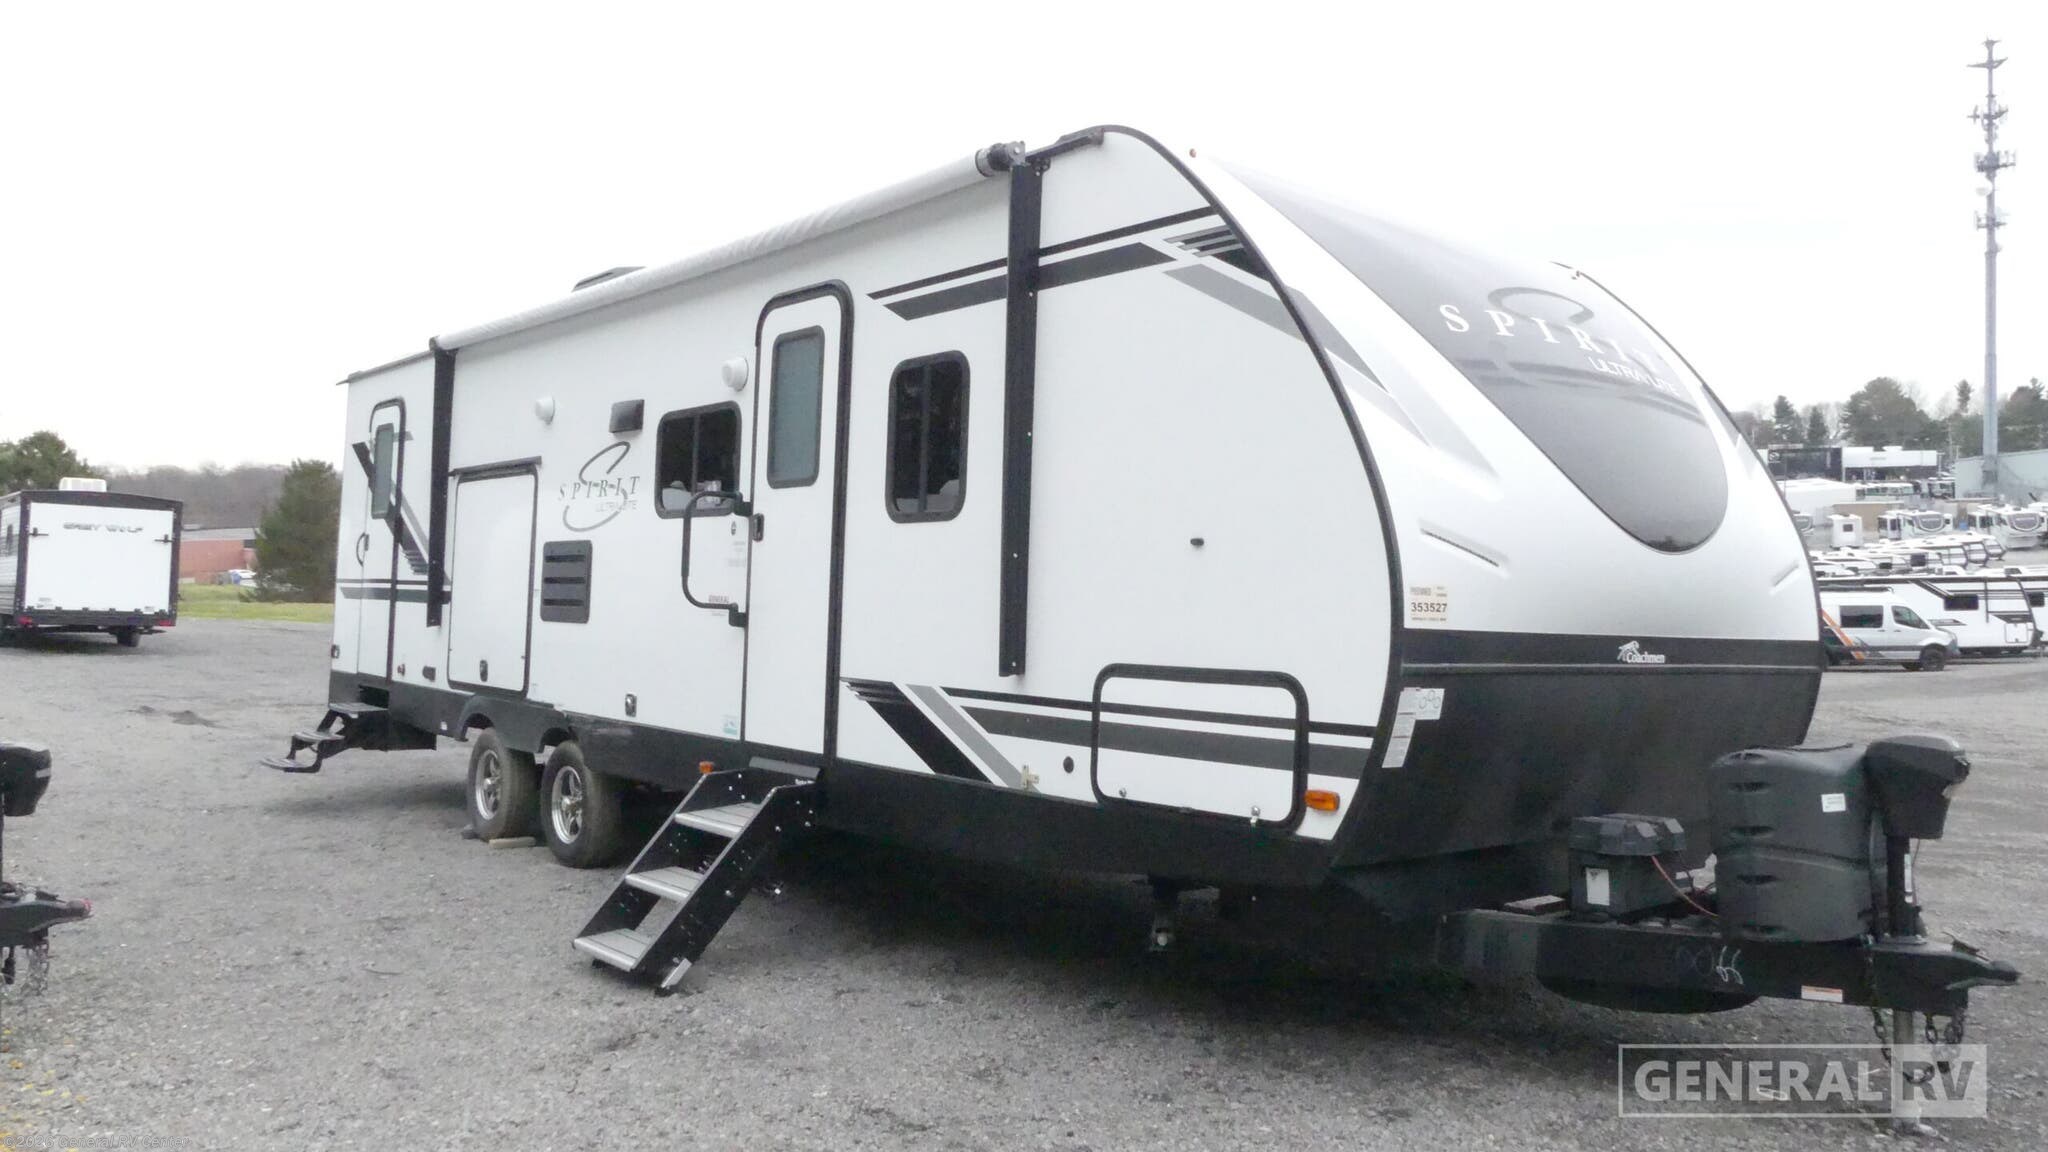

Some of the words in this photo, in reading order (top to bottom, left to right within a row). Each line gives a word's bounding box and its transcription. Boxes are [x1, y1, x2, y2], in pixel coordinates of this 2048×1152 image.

[1439, 304, 1657, 373] SPIRIT
[558, 476, 640, 501] SPIRIT
[1411, 602, 1447, 613] 353527
[1625, 651, 1665, 664] Coachmen
